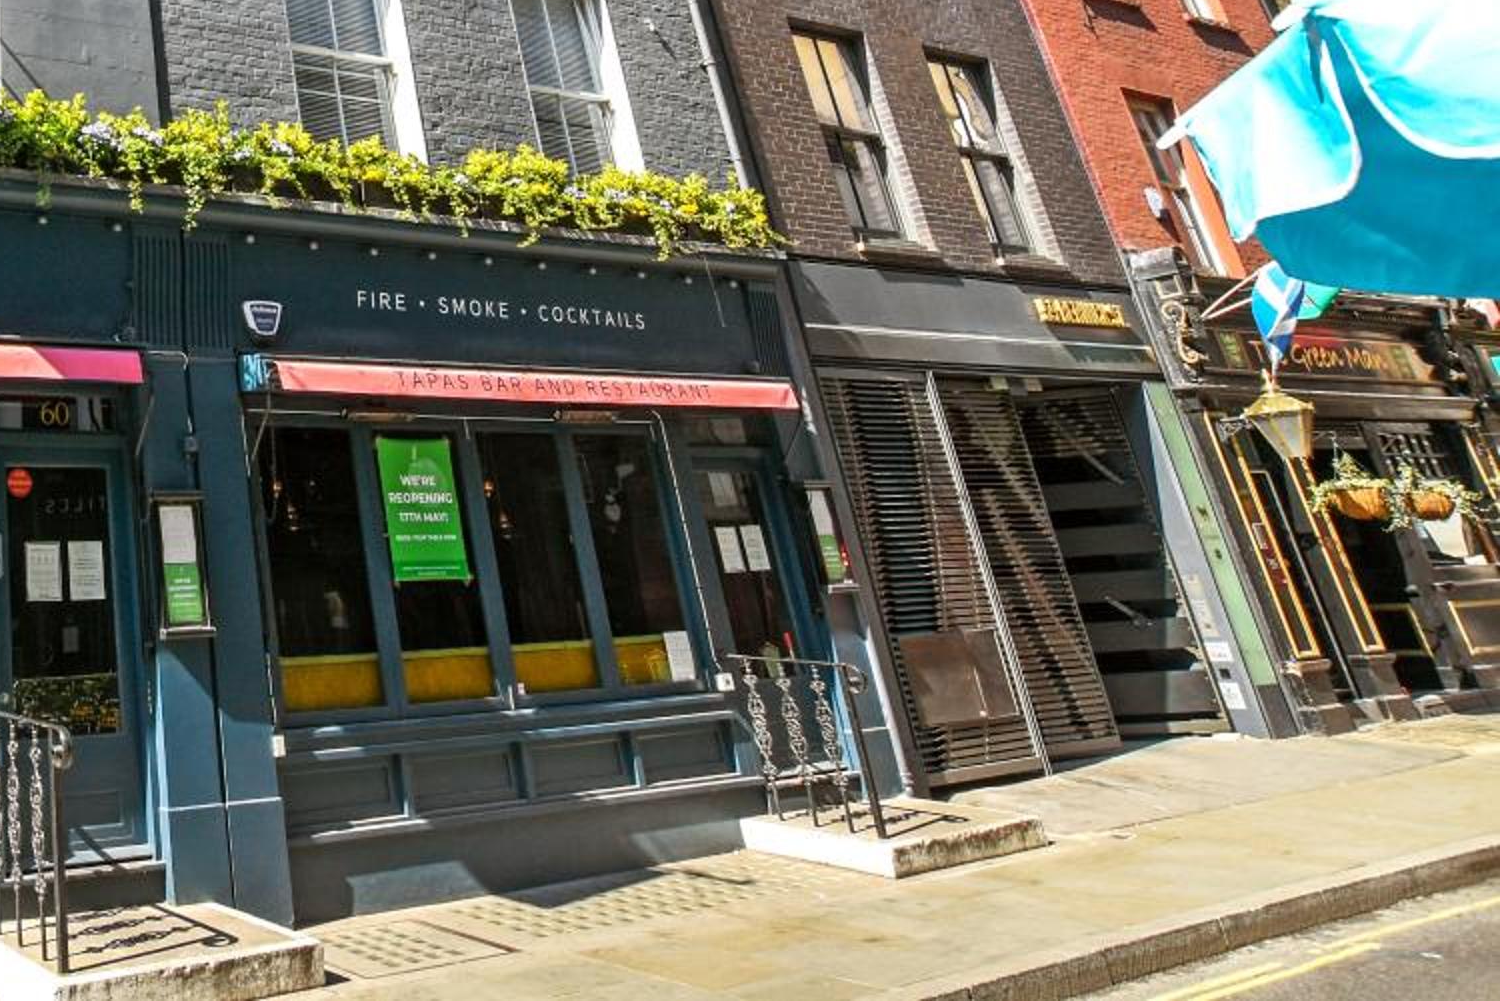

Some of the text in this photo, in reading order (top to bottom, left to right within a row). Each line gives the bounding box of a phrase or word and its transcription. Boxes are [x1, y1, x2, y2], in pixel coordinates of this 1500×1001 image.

[356, 290, 646, 331] FIRE SMOKE COCKTAILS
[396, 370, 713, 401] TAPAS BAR AND RESTAURANT
[40, 401, 69, 426] 60
[388, 492, 453, 503] REOPENING
